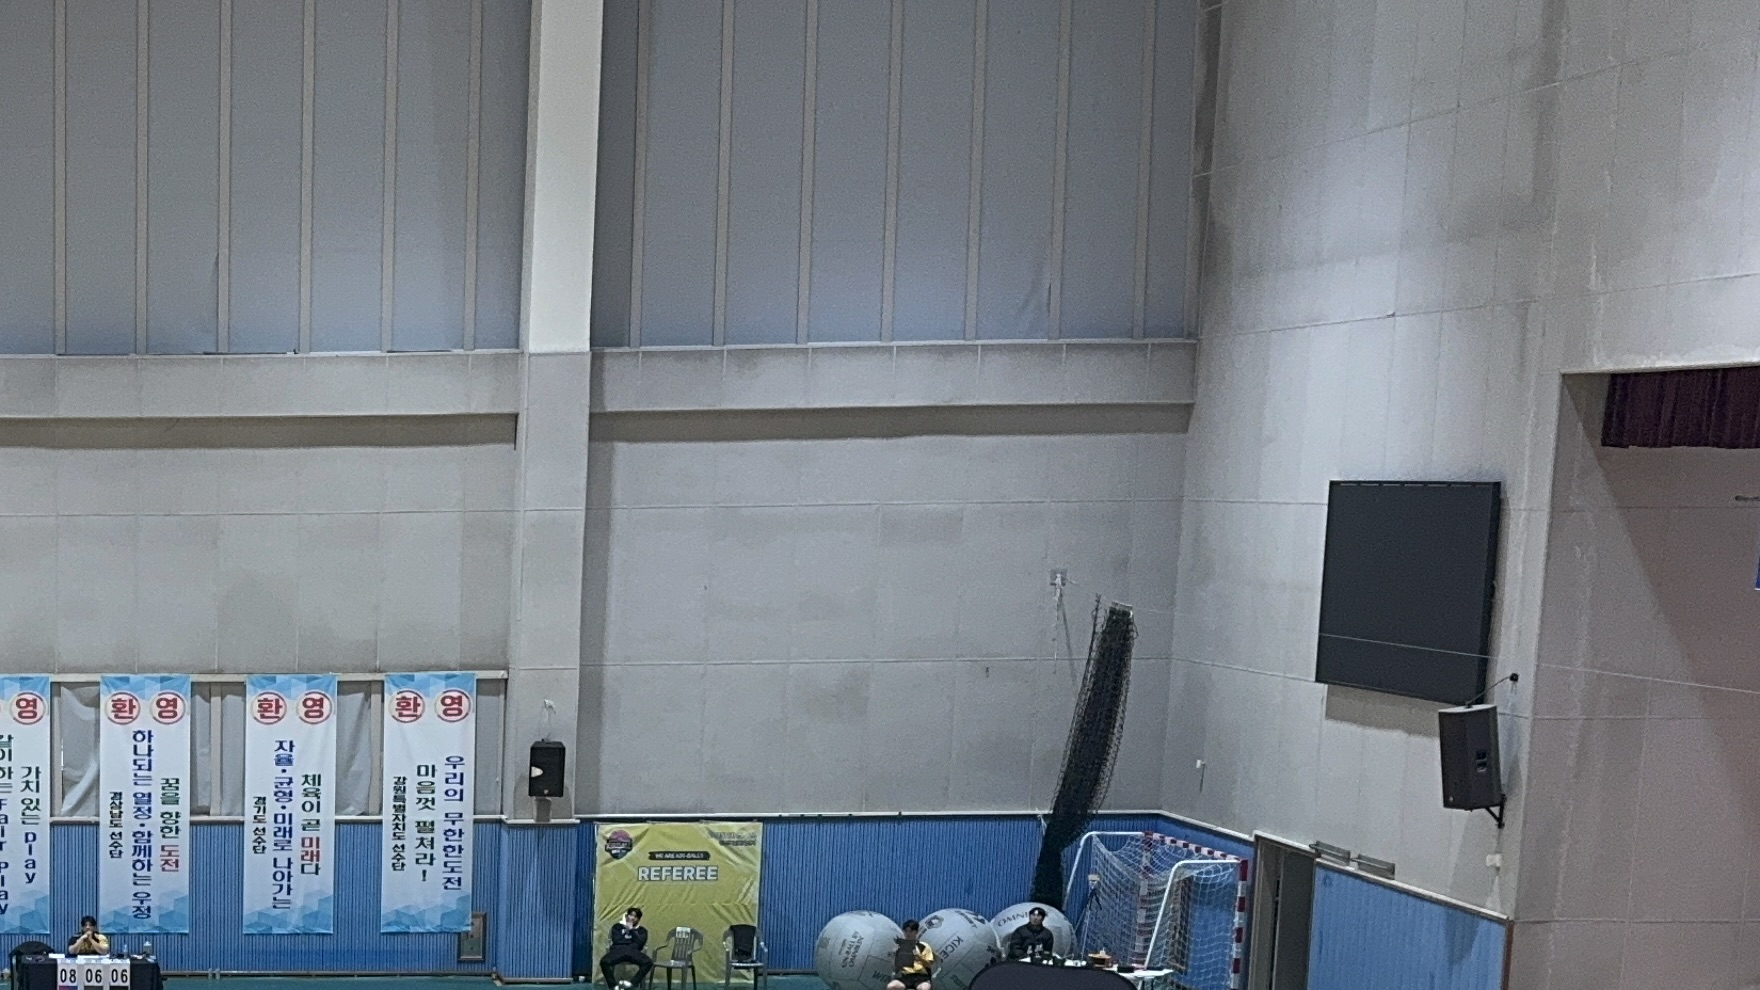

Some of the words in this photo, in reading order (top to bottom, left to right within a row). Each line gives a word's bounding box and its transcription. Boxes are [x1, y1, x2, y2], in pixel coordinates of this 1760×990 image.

[111, 698, 178, 719] 환영
[258, 697, 324, 719] 환영
[396, 696, 462, 717] 환영
[132, 730, 153, 786] 하나되는
[20, 766, 41, 793] 가치
[160, 778, 180, 805] 꿈을
[416, 765, 437, 811] 마음껏
[444, 756, 465, 802] 우리의
[301, 774, 321, 813] 체육이
[20, 798, 41, 825] 있는
[109, 792, 123, 828] 경상남도
[253, 796, 267, 824] 경기도
[392, 776, 406, 840] 강원특별자치도
[160, 812, 180, 839] 향한
[301, 819, 320, 831] 곧
[109, 831, 123, 858] 선수단
[252, 827, 267, 854] 선수단
[415, 821, 437, 882] 펼쳐라!
[25, 832, 36, 883] play
[160, 845, 180, 872] 도전
[301, 837, 320, 875] 미래다
[391, 844, 406, 871] 선수단
[272, 857, 293, 909] 나아가는
[638, 866, 718, 881] REFEREE
[132, 892, 153, 919] 우정
[997, 911, 1030, 927] OMNI
[60, 969, 77, 983] 08
[85, 969, 102, 983] 06
[111, 969, 128, 983] 06
